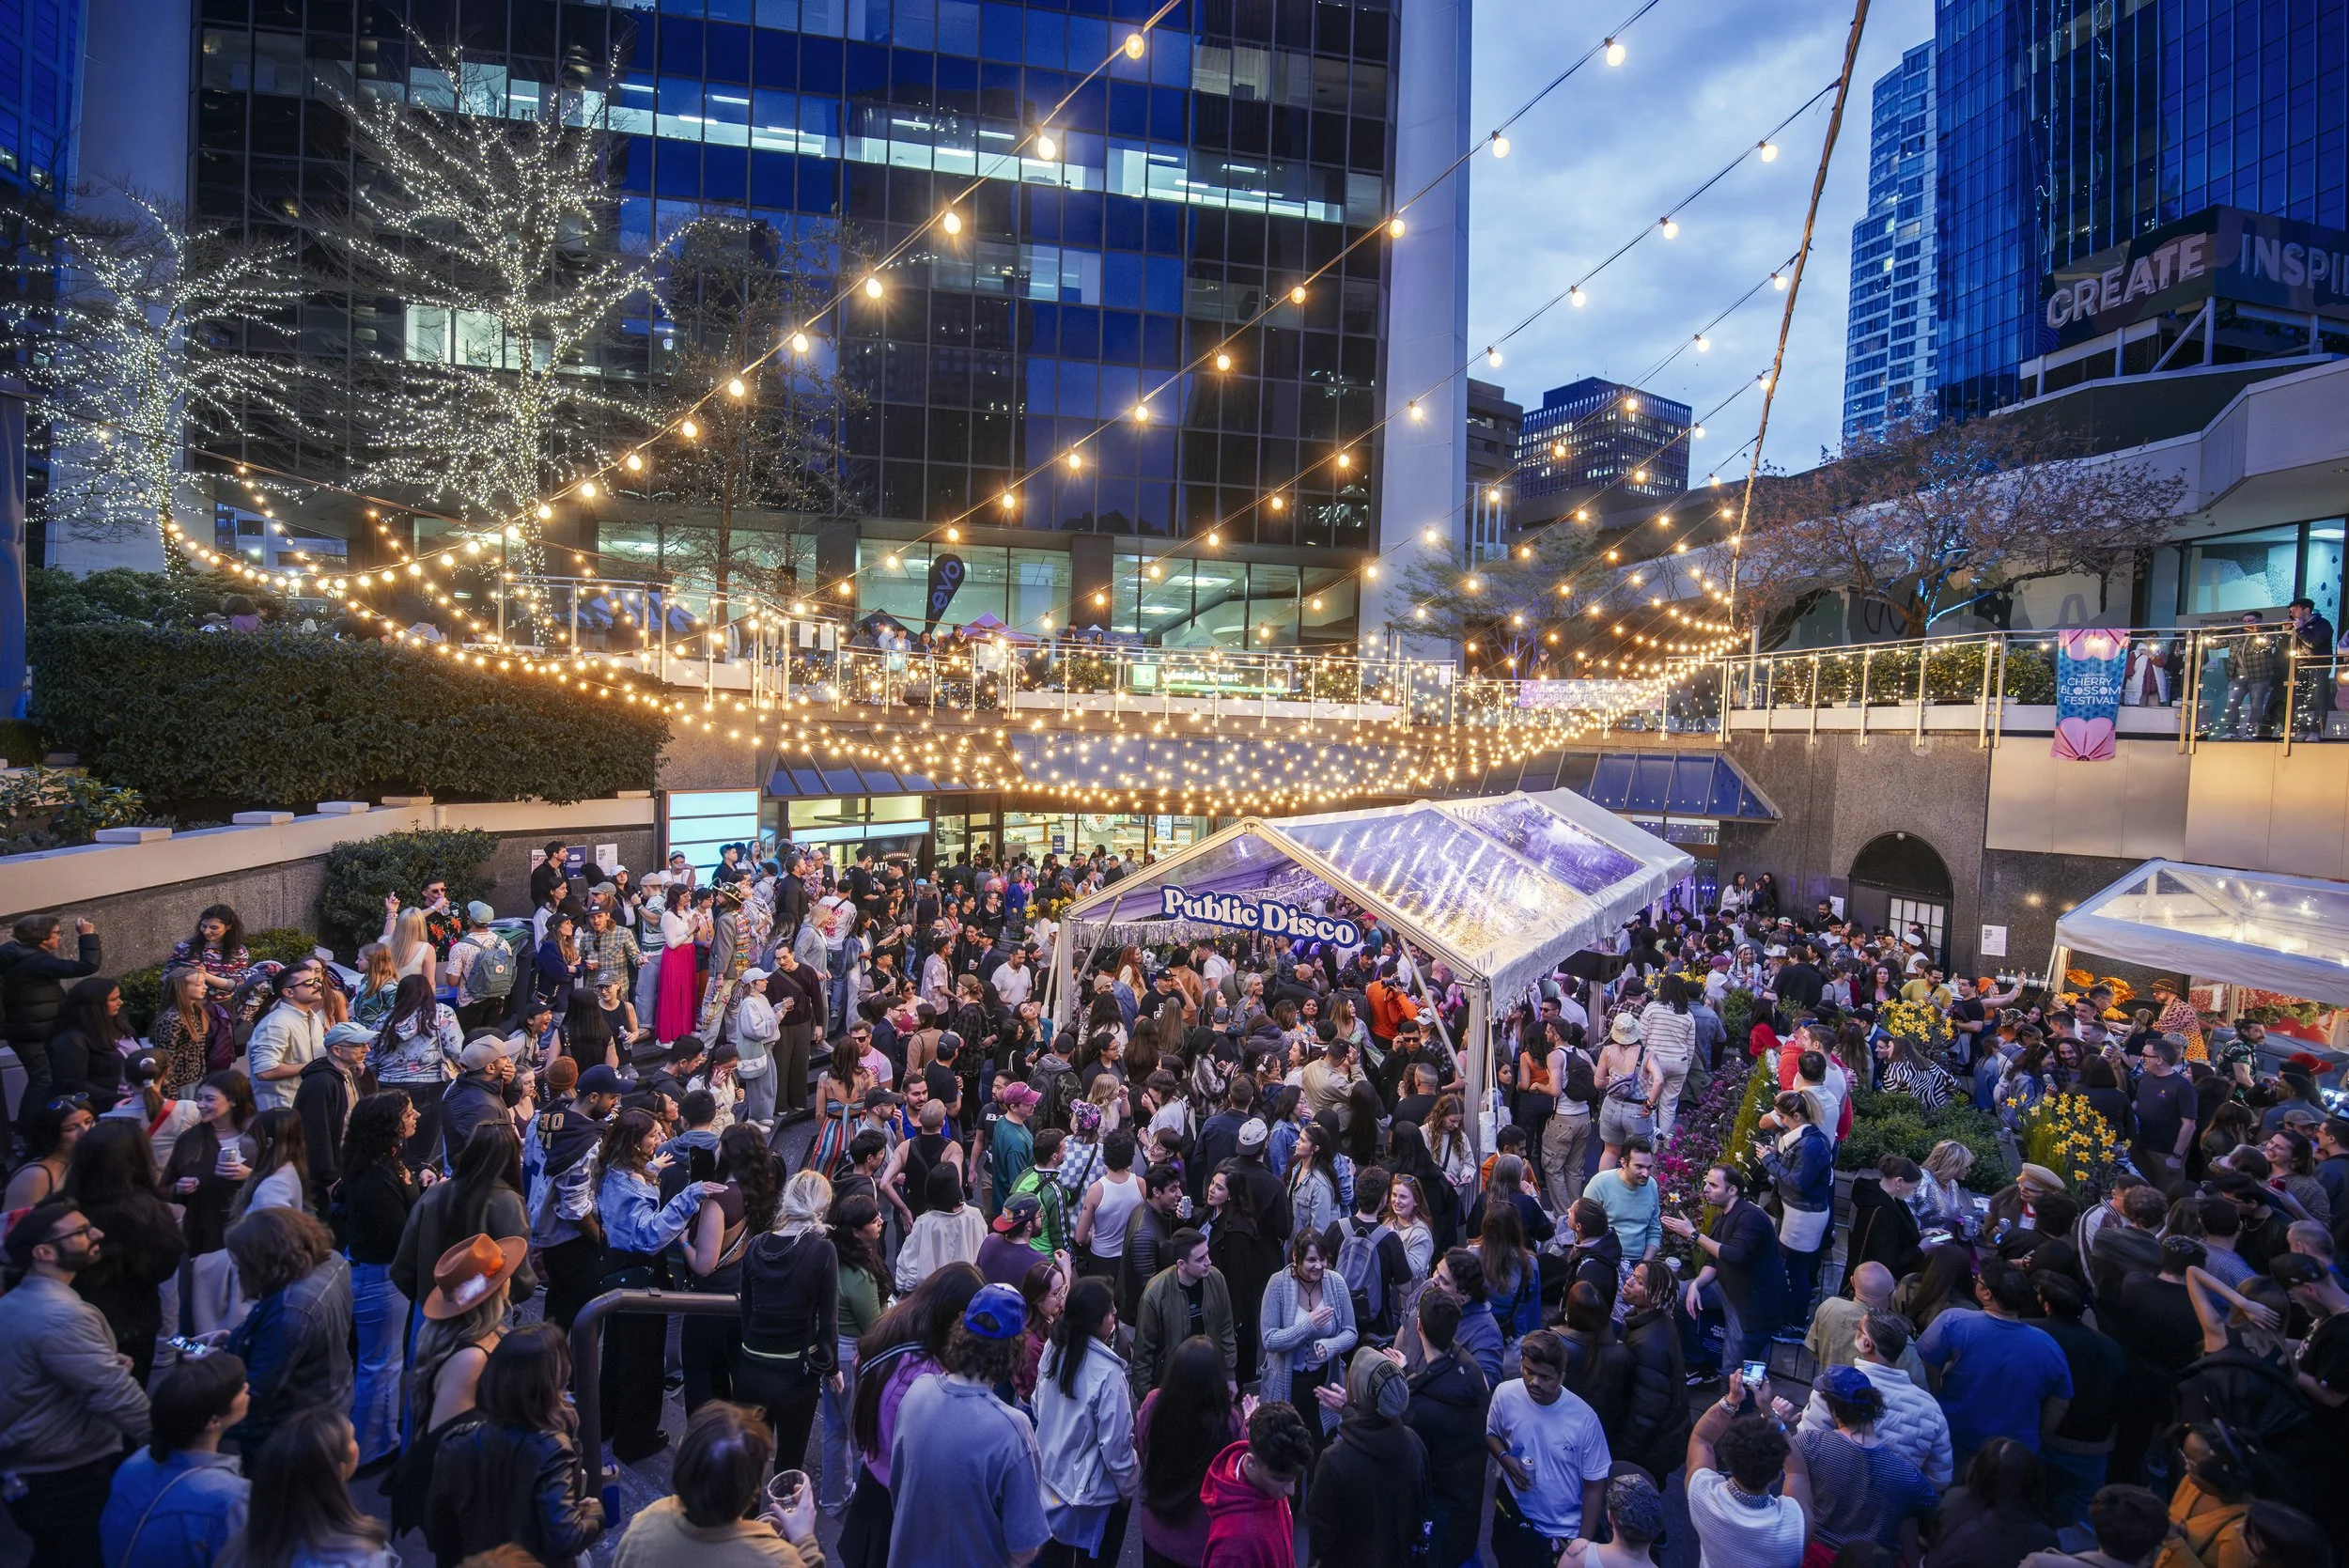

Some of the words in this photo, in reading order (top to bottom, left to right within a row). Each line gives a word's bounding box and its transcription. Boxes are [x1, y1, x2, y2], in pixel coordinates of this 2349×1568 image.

[2046, 232, 2208, 328] CREATE
[1161, 670, 1205, 681] anada
[2067, 677, 2113, 686] CHERRY
[2061, 685, 2121, 695] BLOSSOM
[2063, 695, 2118, 706] FESTIVAL
[1164, 889, 1258, 927] Public
[1262, 903, 1355, 944] Disco
